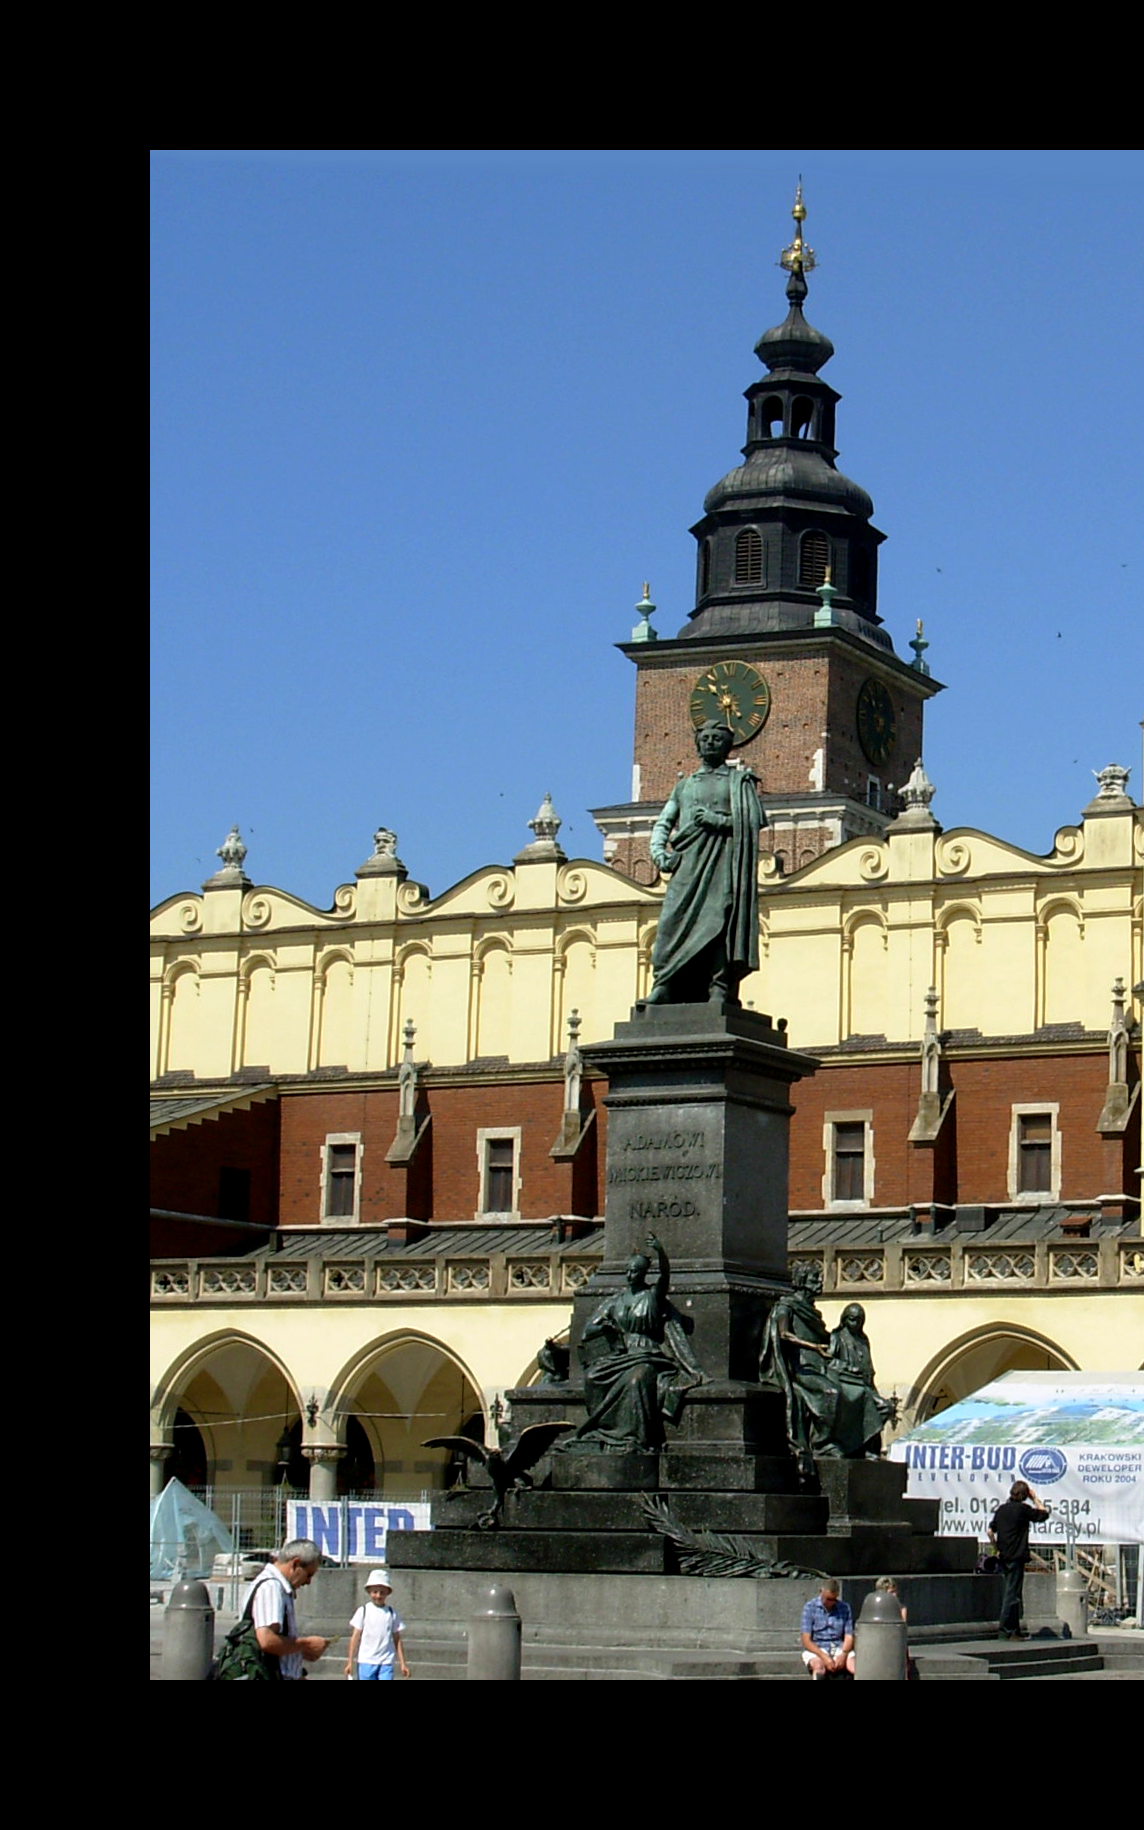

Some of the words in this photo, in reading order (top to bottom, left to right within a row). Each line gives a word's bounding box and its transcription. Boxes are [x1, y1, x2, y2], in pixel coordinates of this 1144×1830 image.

[905, 1444, 1017, 1471] INTER-BUD
[1079, 1452, 1142, 1461] KRAKOWSKI
[1077, 1464, 1142, 1473] DEWELOPER
[907, 1472, 1017, 1483] EVELOPER
[1082, 1474, 1112, 1483] ROKU
[1114, 1474, 1137, 1483] 2004
[943, 1497, 965, 1514] el.
[969, 1497, 1001, 1514] 012
